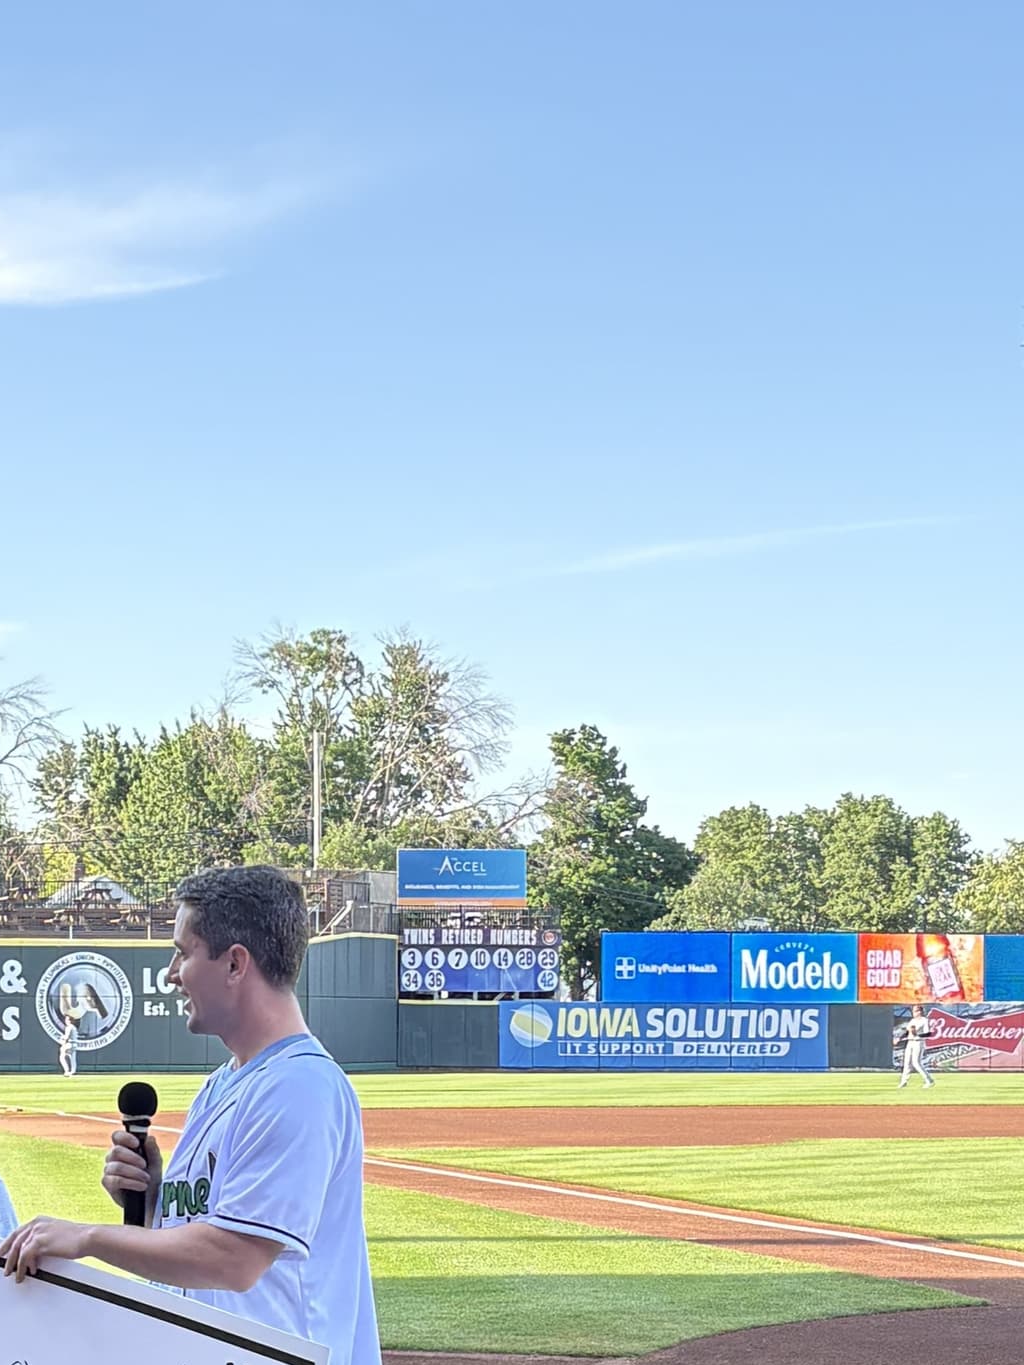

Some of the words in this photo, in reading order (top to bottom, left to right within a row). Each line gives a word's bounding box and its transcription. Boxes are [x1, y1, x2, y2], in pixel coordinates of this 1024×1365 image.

[404, 929, 435, 945] TWINS
[442, 929, 483, 945] RETIRED
[490, 929, 537, 945] NUMBERS
[407, 949, 416, 966] 3
[431, 949, 439, 966] 6
[454, 951, 464, 967] 7
[475, 950, 486, 966] 10
[498, 951, 509, 966] 14
[518, 951, 533, 966] 28
[541, 951, 555, 966] 29
[867, 950, 902, 968] GRAB
[0, 959, 28, 994] &
[740, 949, 848, 990] Modelo
[867, 969, 901, 988] GOLD
[143, 967, 176, 994] LO
[404, 972, 419, 987] 34
[427, 972, 442, 987] 36
[540, 972, 554, 987] 42
[143, 1001, 170, 1016] Est.
[557, 1007, 640, 1038] IOWA
[645, 1008, 819, 1039] SOLUTIONS
[928, 1017, 1024, 1040] Budweiser
[566, 1042, 583, 1054] IT
[587, 1042, 665, 1055] SUPPORT
[683, 1043, 782, 1054] DELIVERED
